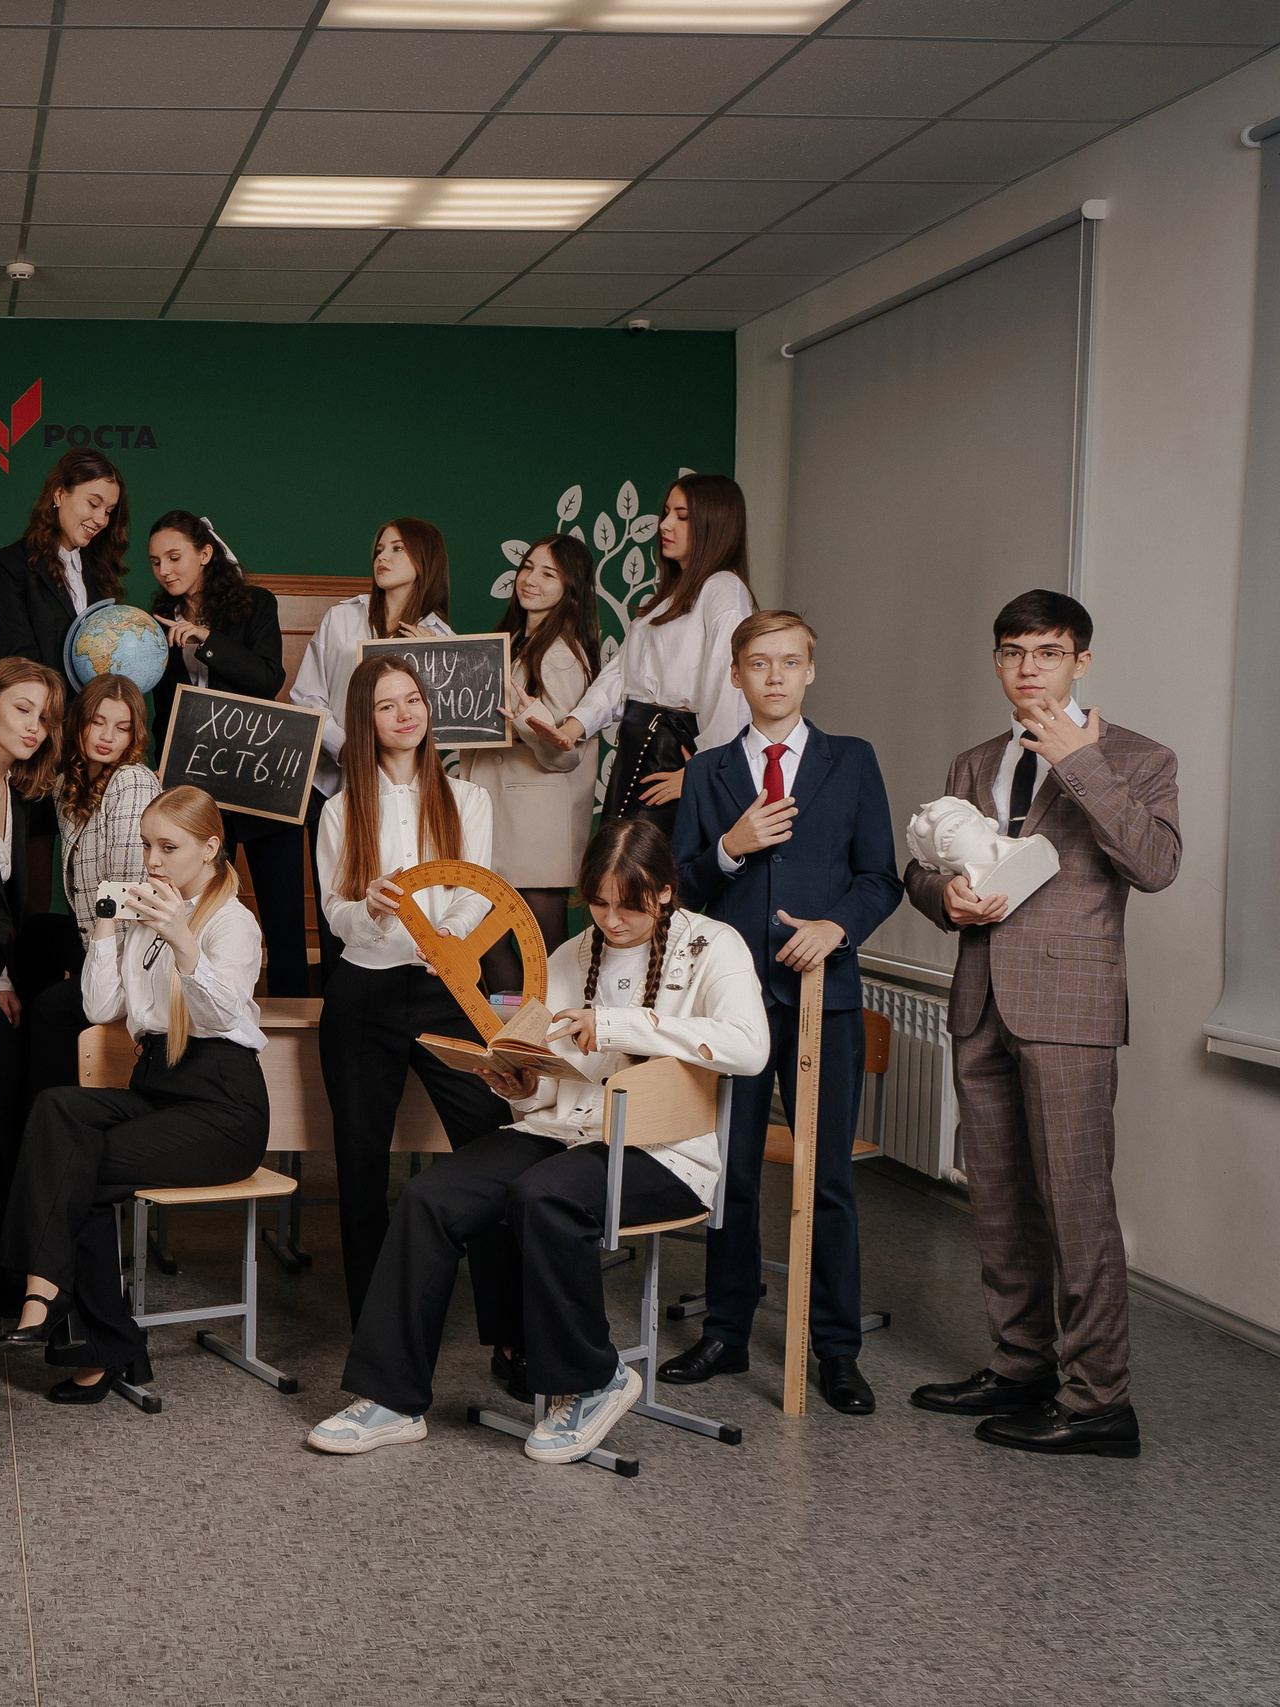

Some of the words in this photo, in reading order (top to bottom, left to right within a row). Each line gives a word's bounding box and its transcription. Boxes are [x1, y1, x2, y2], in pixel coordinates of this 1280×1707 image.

[44, 424, 158, 449] РОСТА
[428, 668, 503, 727] МОЙ!
[196, 701, 284, 746] ХОЧУ
[185, 744, 304, 789] ЕСТЬ!!!
